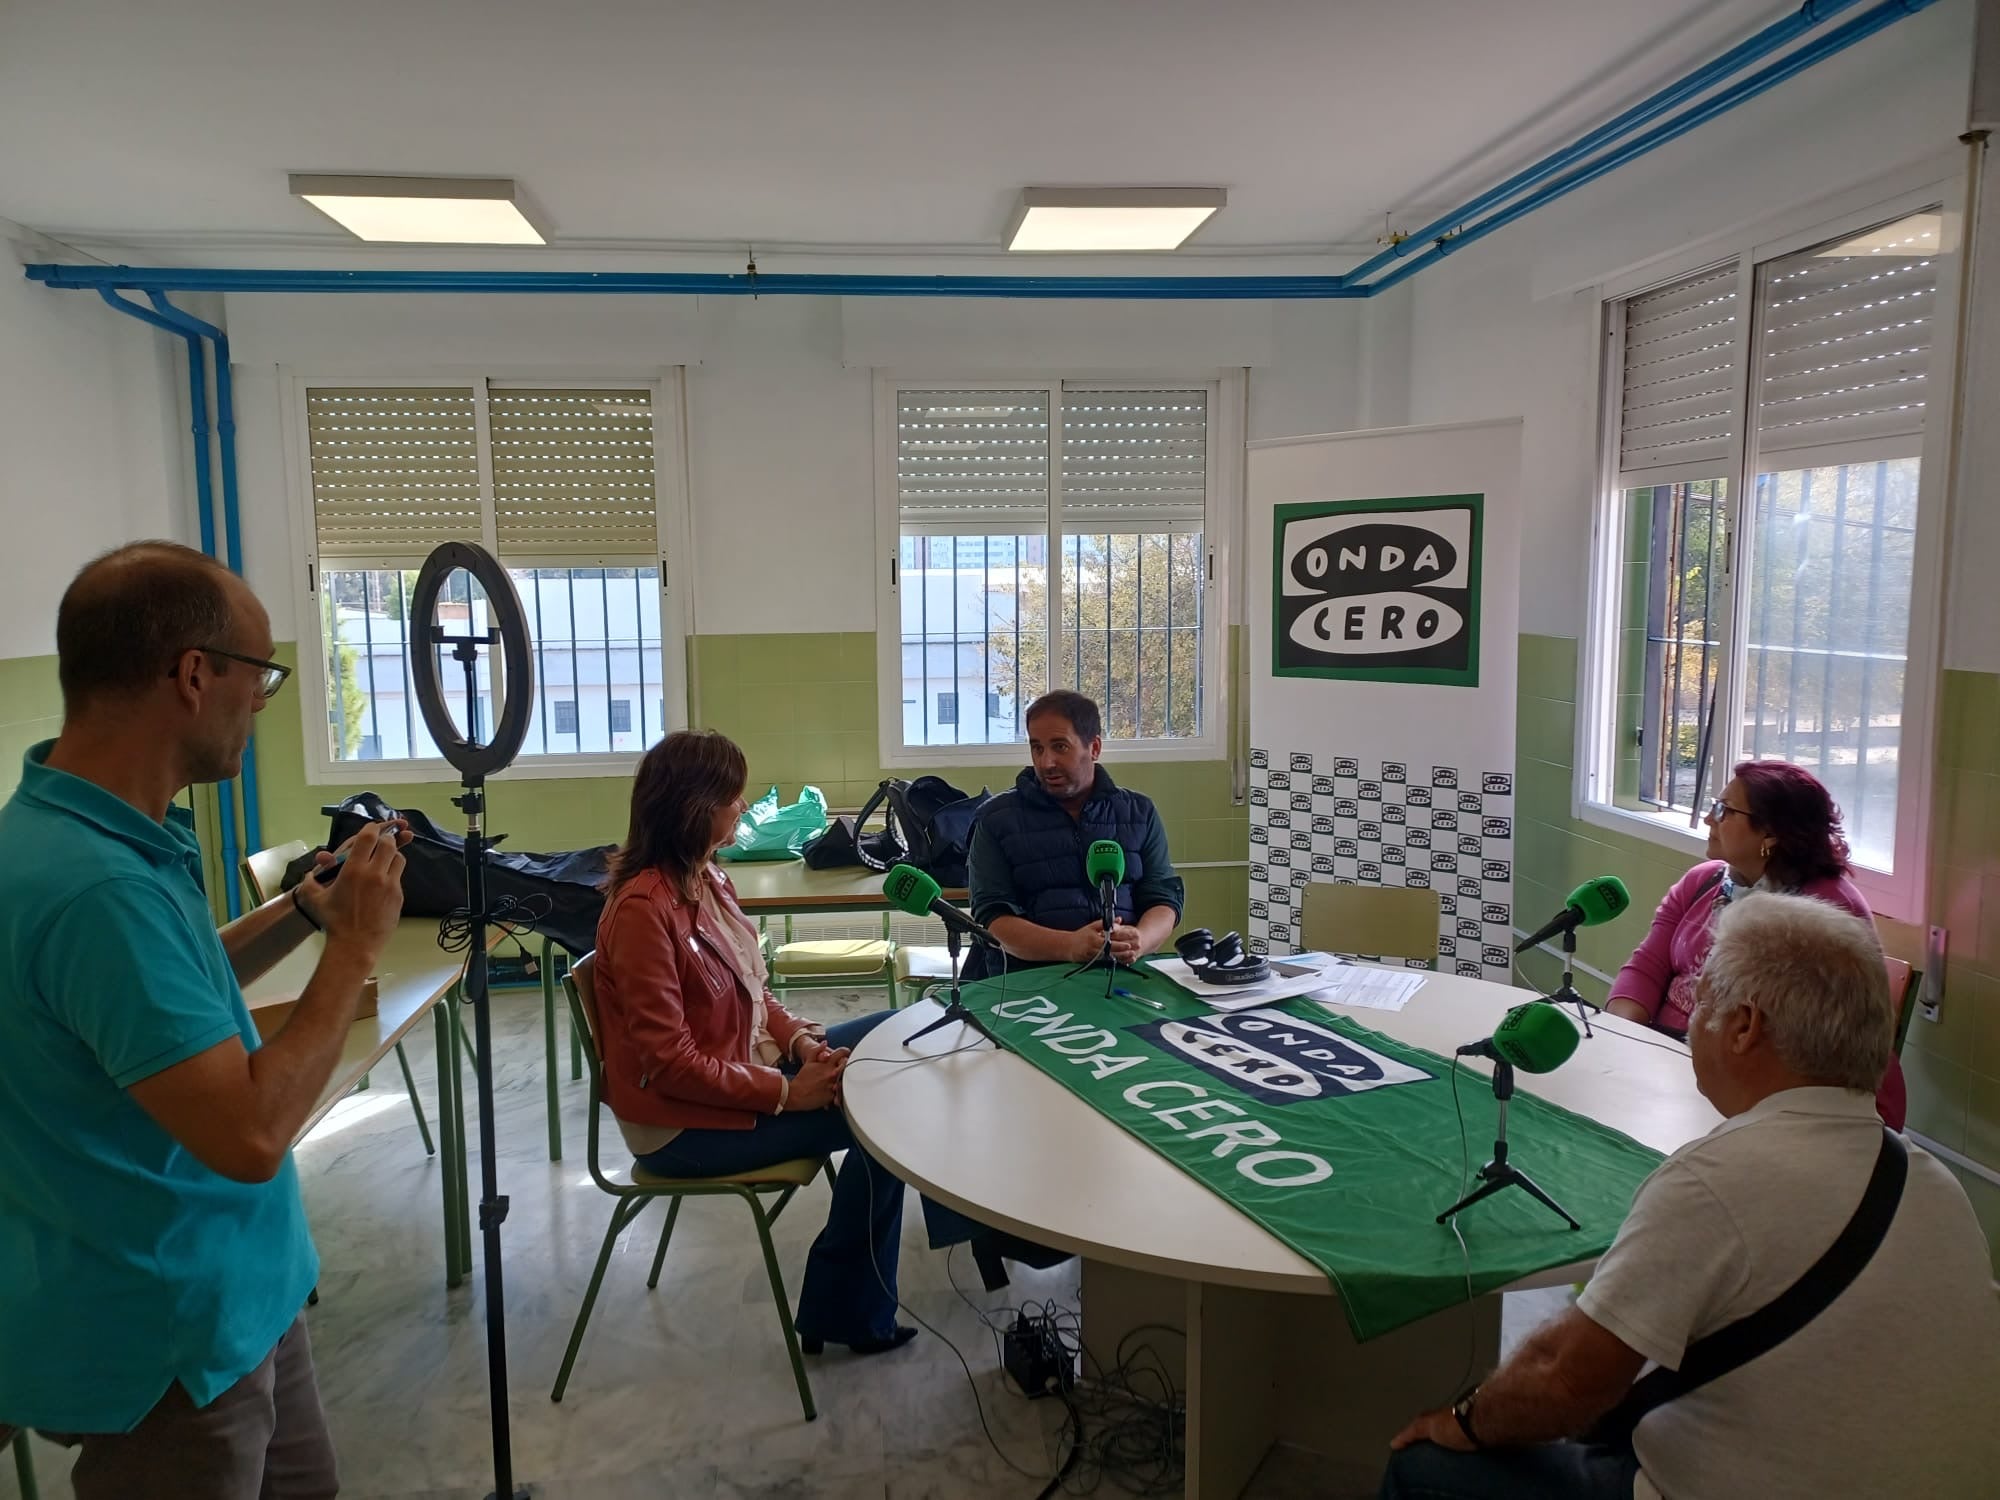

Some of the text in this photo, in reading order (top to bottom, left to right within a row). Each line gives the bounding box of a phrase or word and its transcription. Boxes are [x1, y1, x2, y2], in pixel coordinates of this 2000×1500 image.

[1306, 544, 1440, 578] ONDA
[1313, 605, 1440, 641] CERO
[1181, 1028, 1304, 1088] CERO
[1239, 1020, 1366, 1075] ONDA
[990, 995, 1334, 1187] ONDA CERO
